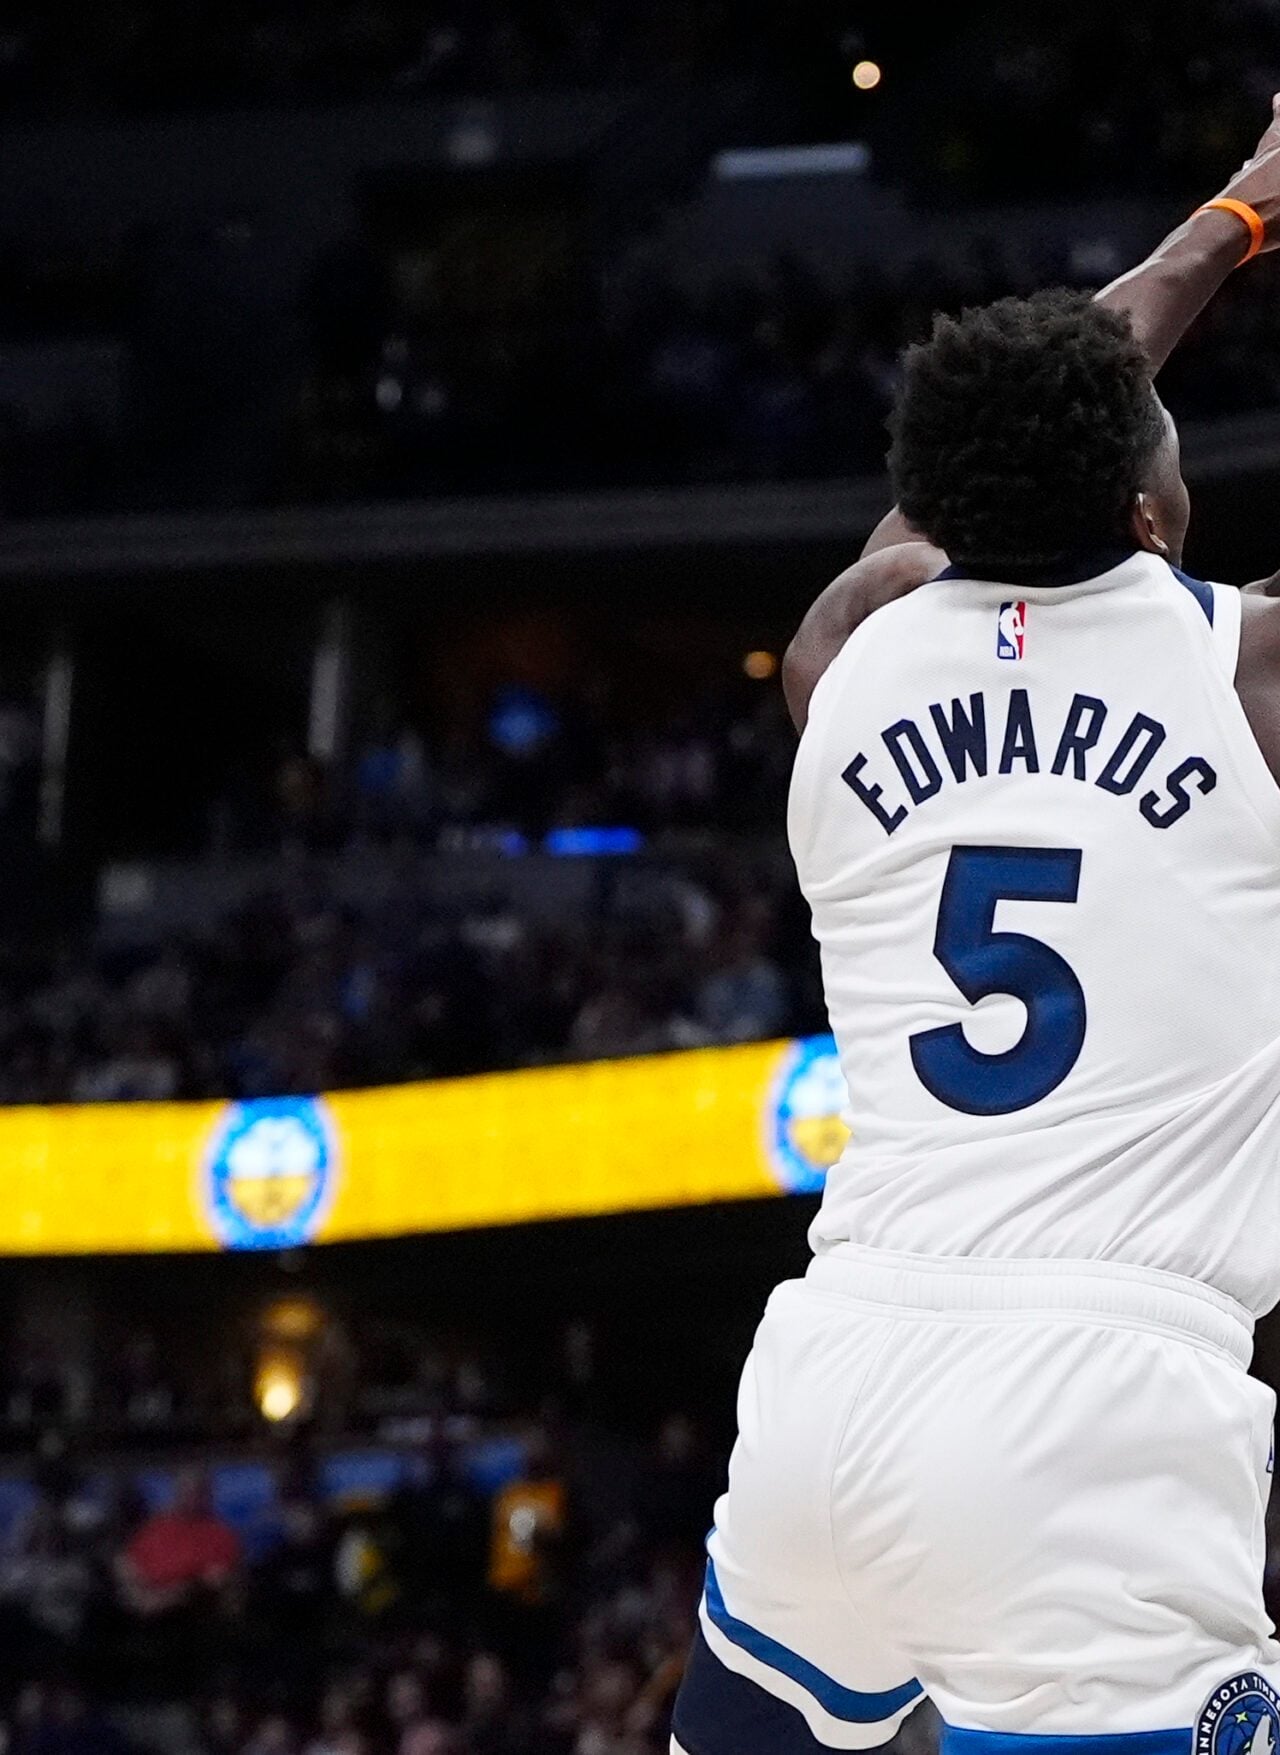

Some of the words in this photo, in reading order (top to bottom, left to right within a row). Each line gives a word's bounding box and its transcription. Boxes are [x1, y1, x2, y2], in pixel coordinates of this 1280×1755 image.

[841, 689, 1217, 836] EDWARDS
[908, 844, 1087, 1116] 5
[1198, 1678, 1249, 1755] INNESOTA
